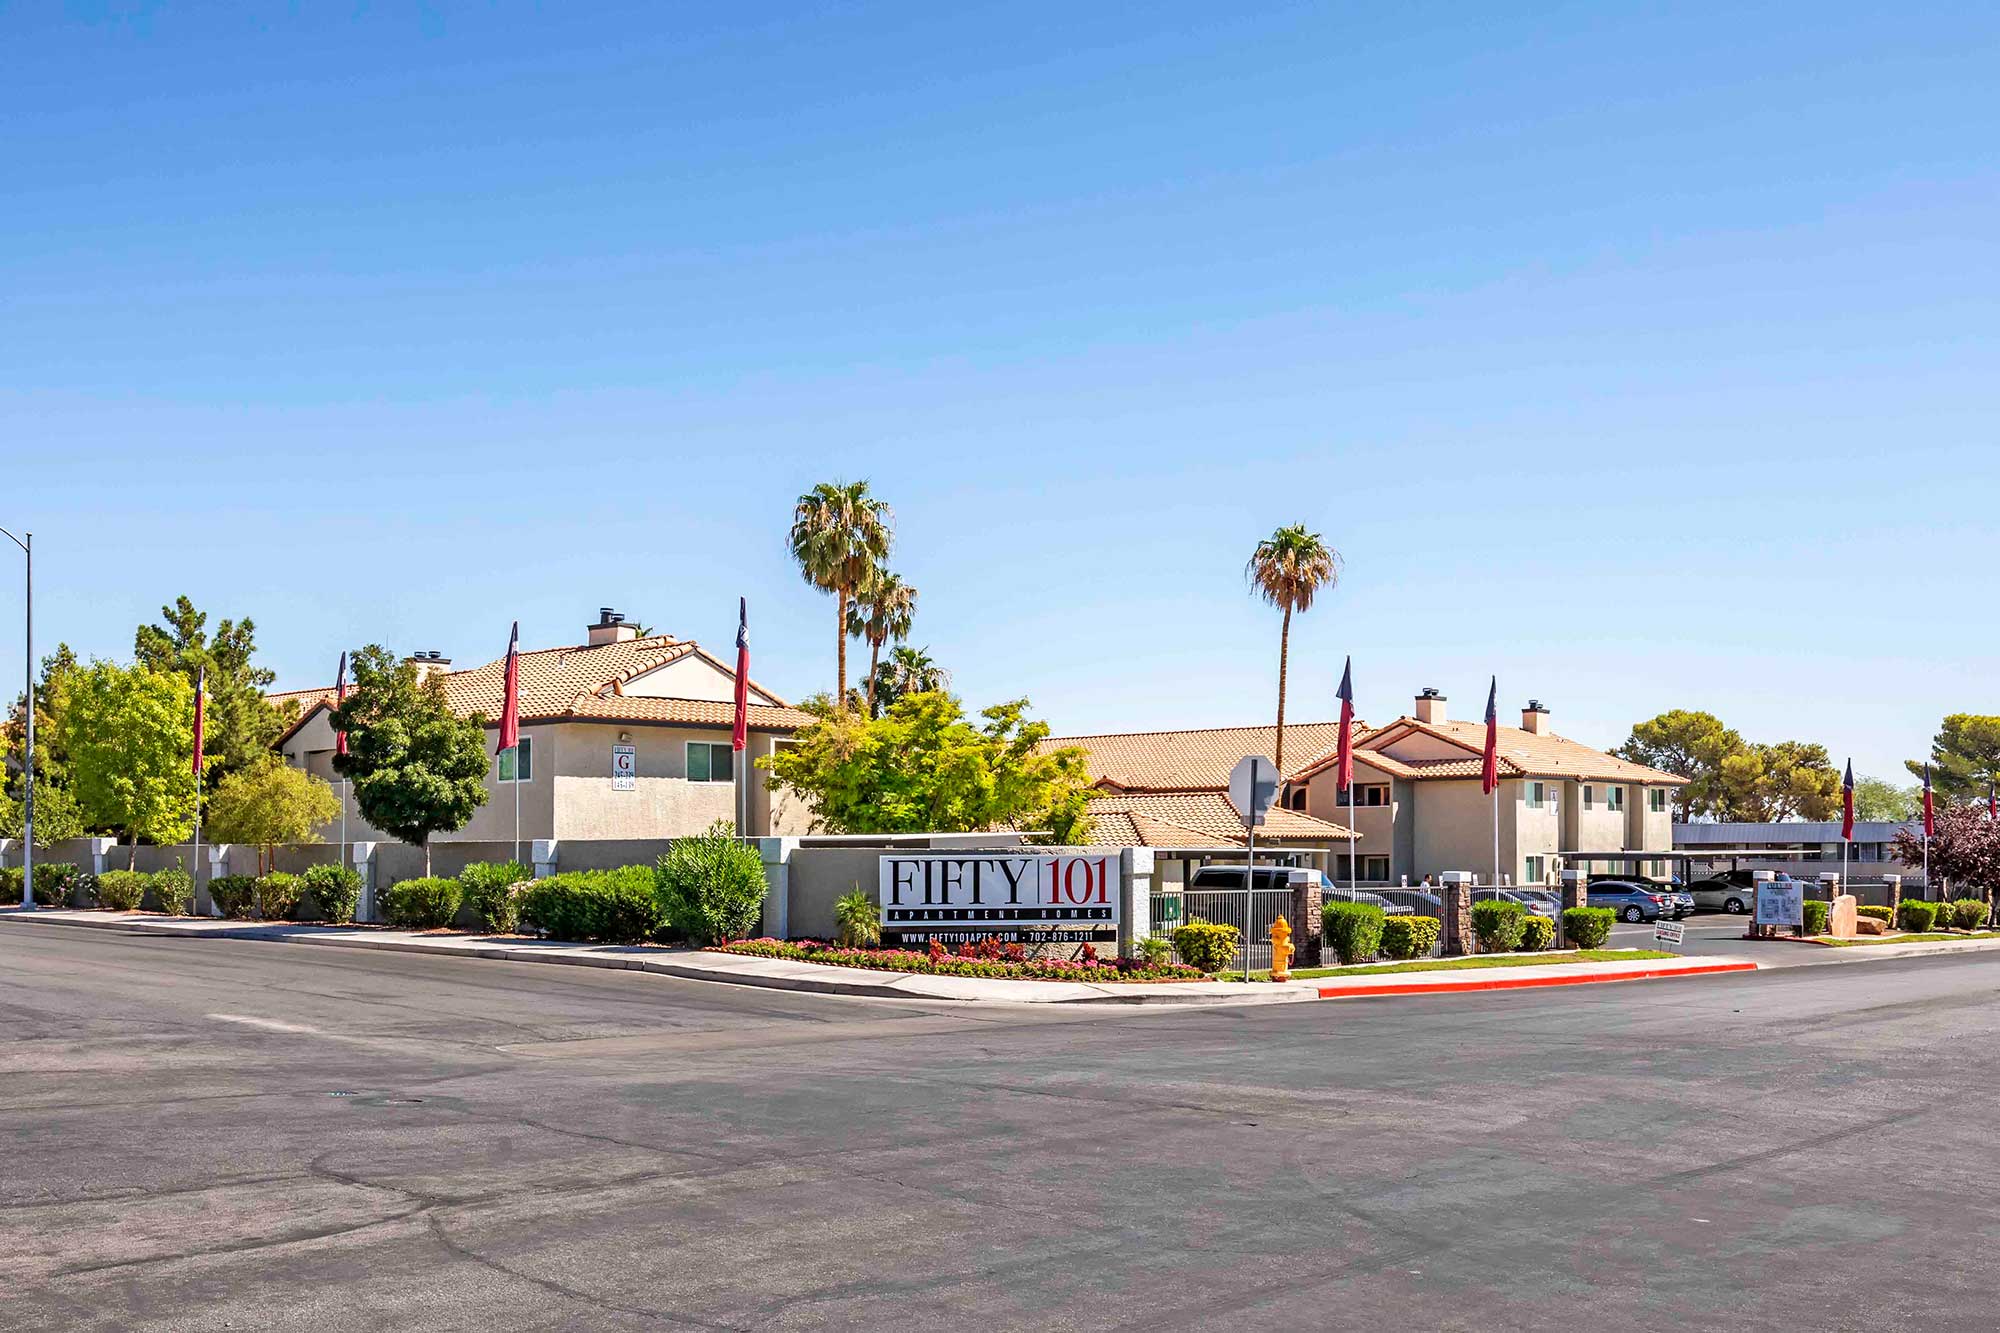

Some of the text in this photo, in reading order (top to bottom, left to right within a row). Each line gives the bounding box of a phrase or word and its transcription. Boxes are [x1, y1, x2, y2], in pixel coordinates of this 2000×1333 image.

[618, 755, 629, 769] G
[888, 857, 1111, 905] FIFTY 101
[894, 909, 1106, 920] APARTMENT HOMES
[901, 931, 1093, 943] WWW.FIFTY101APTSCOM 702-876-1211
